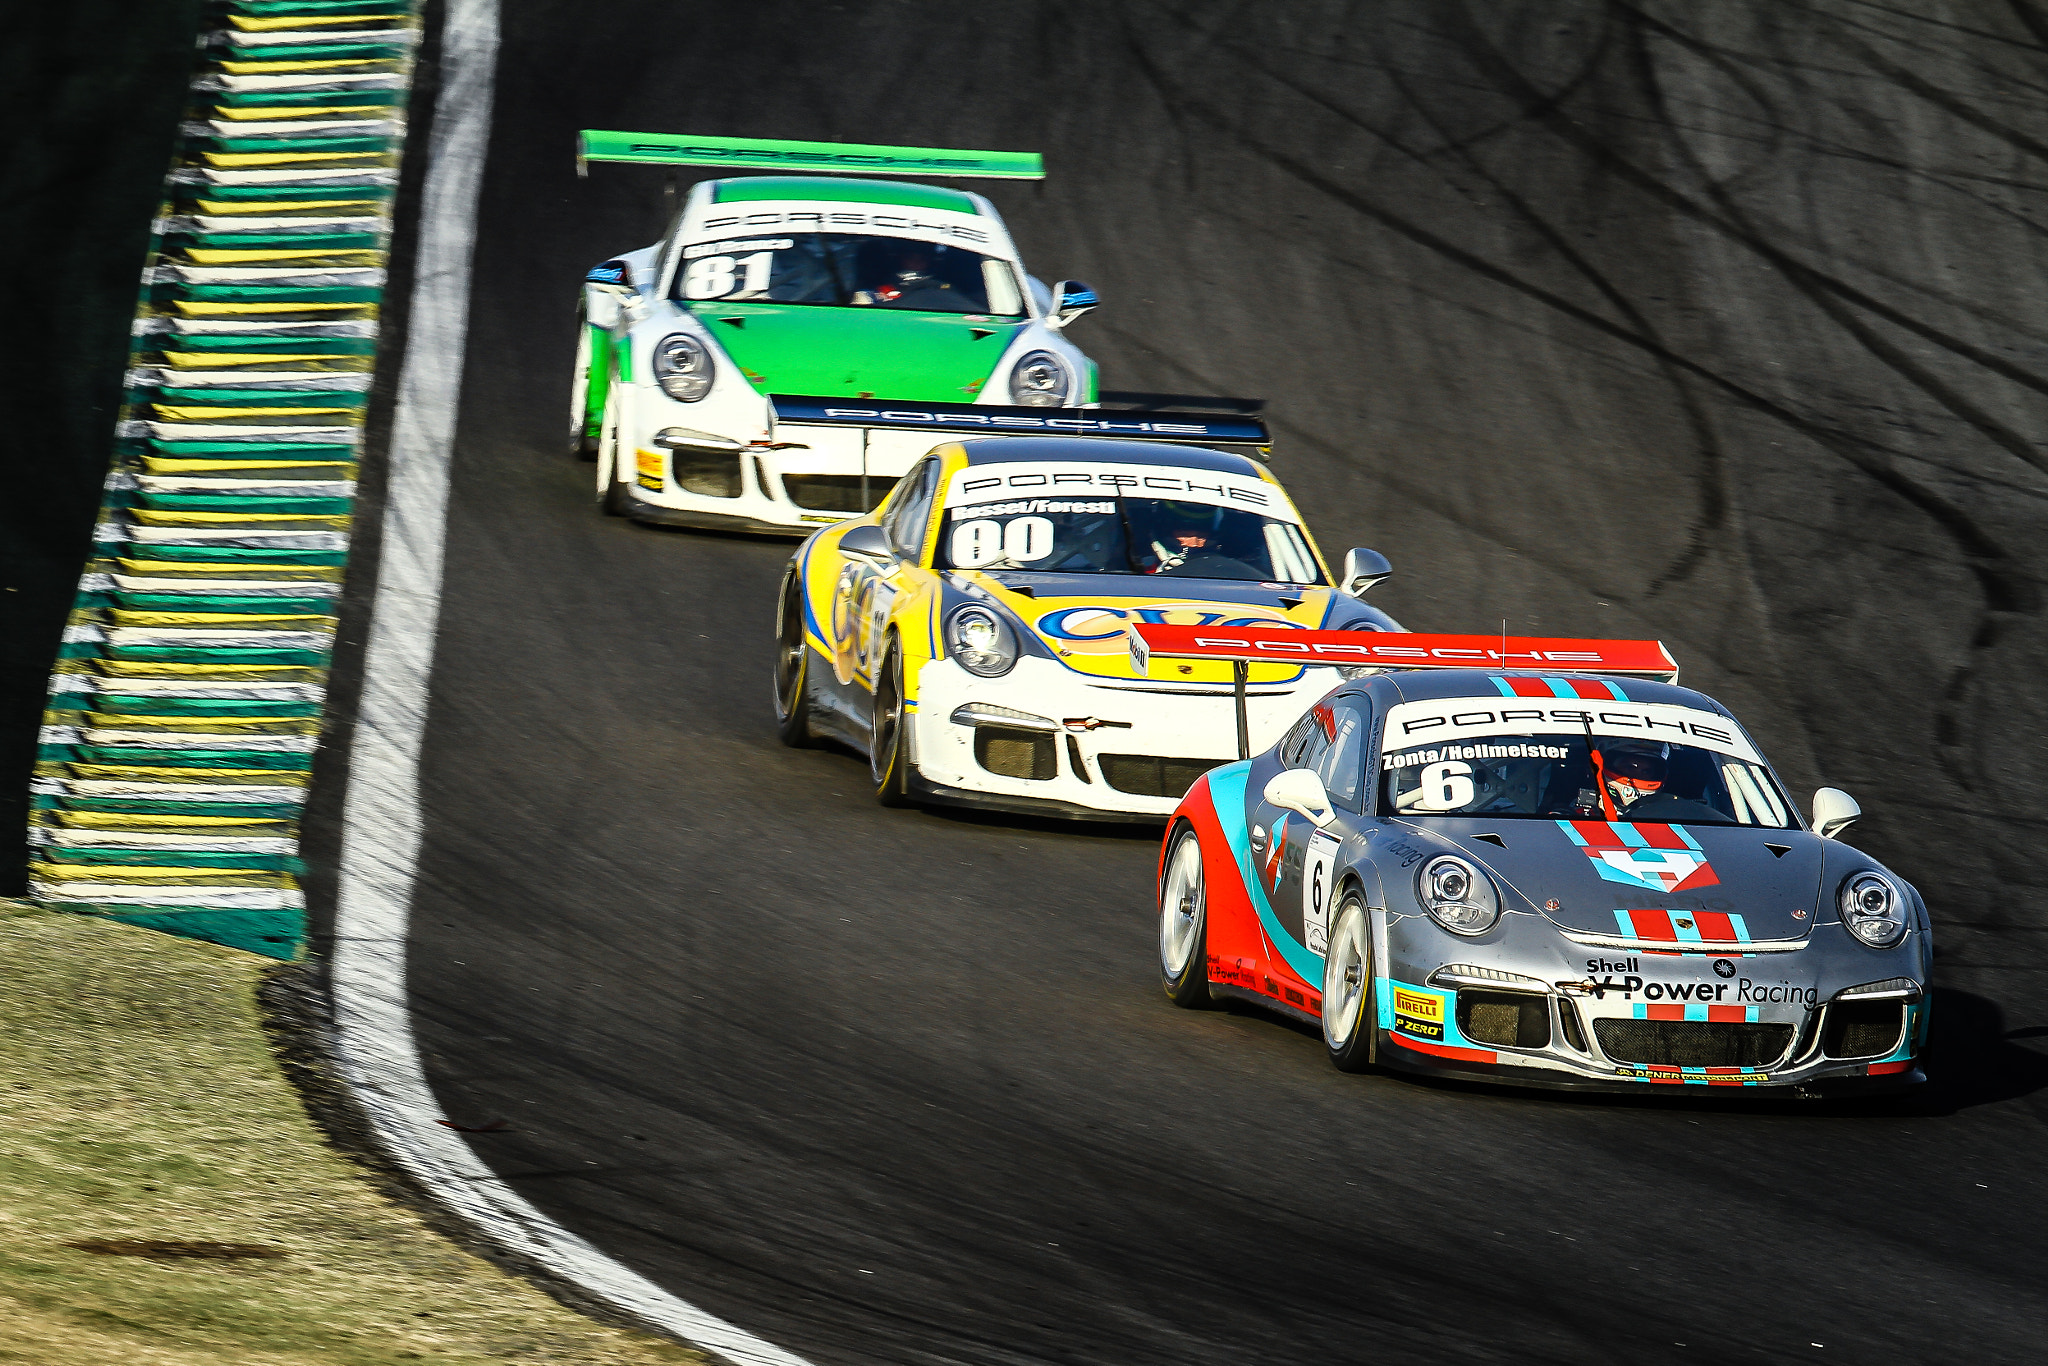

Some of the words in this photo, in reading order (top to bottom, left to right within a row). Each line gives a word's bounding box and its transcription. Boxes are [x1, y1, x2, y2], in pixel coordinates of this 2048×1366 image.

[630, 143, 984, 168] PORSCHE
[703, 212, 989, 244] PORSCHE
[684, 251, 774, 300] 81
[823, 407, 1208, 434] PORSCHE
[962, 473, 1269, 507] PORSCHE
[1194, 636, 1604, 662] PORSCHE
[1401, 709, 1734, 746] PORSCHE
[1382, 743, 1569, 771] Zonta/Hellmeister
[1420, 760, 1475, 811] 6
[1312, 860, 1324, 915] 6
[1587, 957, 1639, 973] Shell
[1396, 991, 1437, 1016] PIRELLI
[1587, 975, 1729, 1001] VPower
[1737, 977, 1819, 1012] Racing
[1404, 1020, 1439, 1036] ZERO
[1635, 1070, 1681, 1080] DENER
